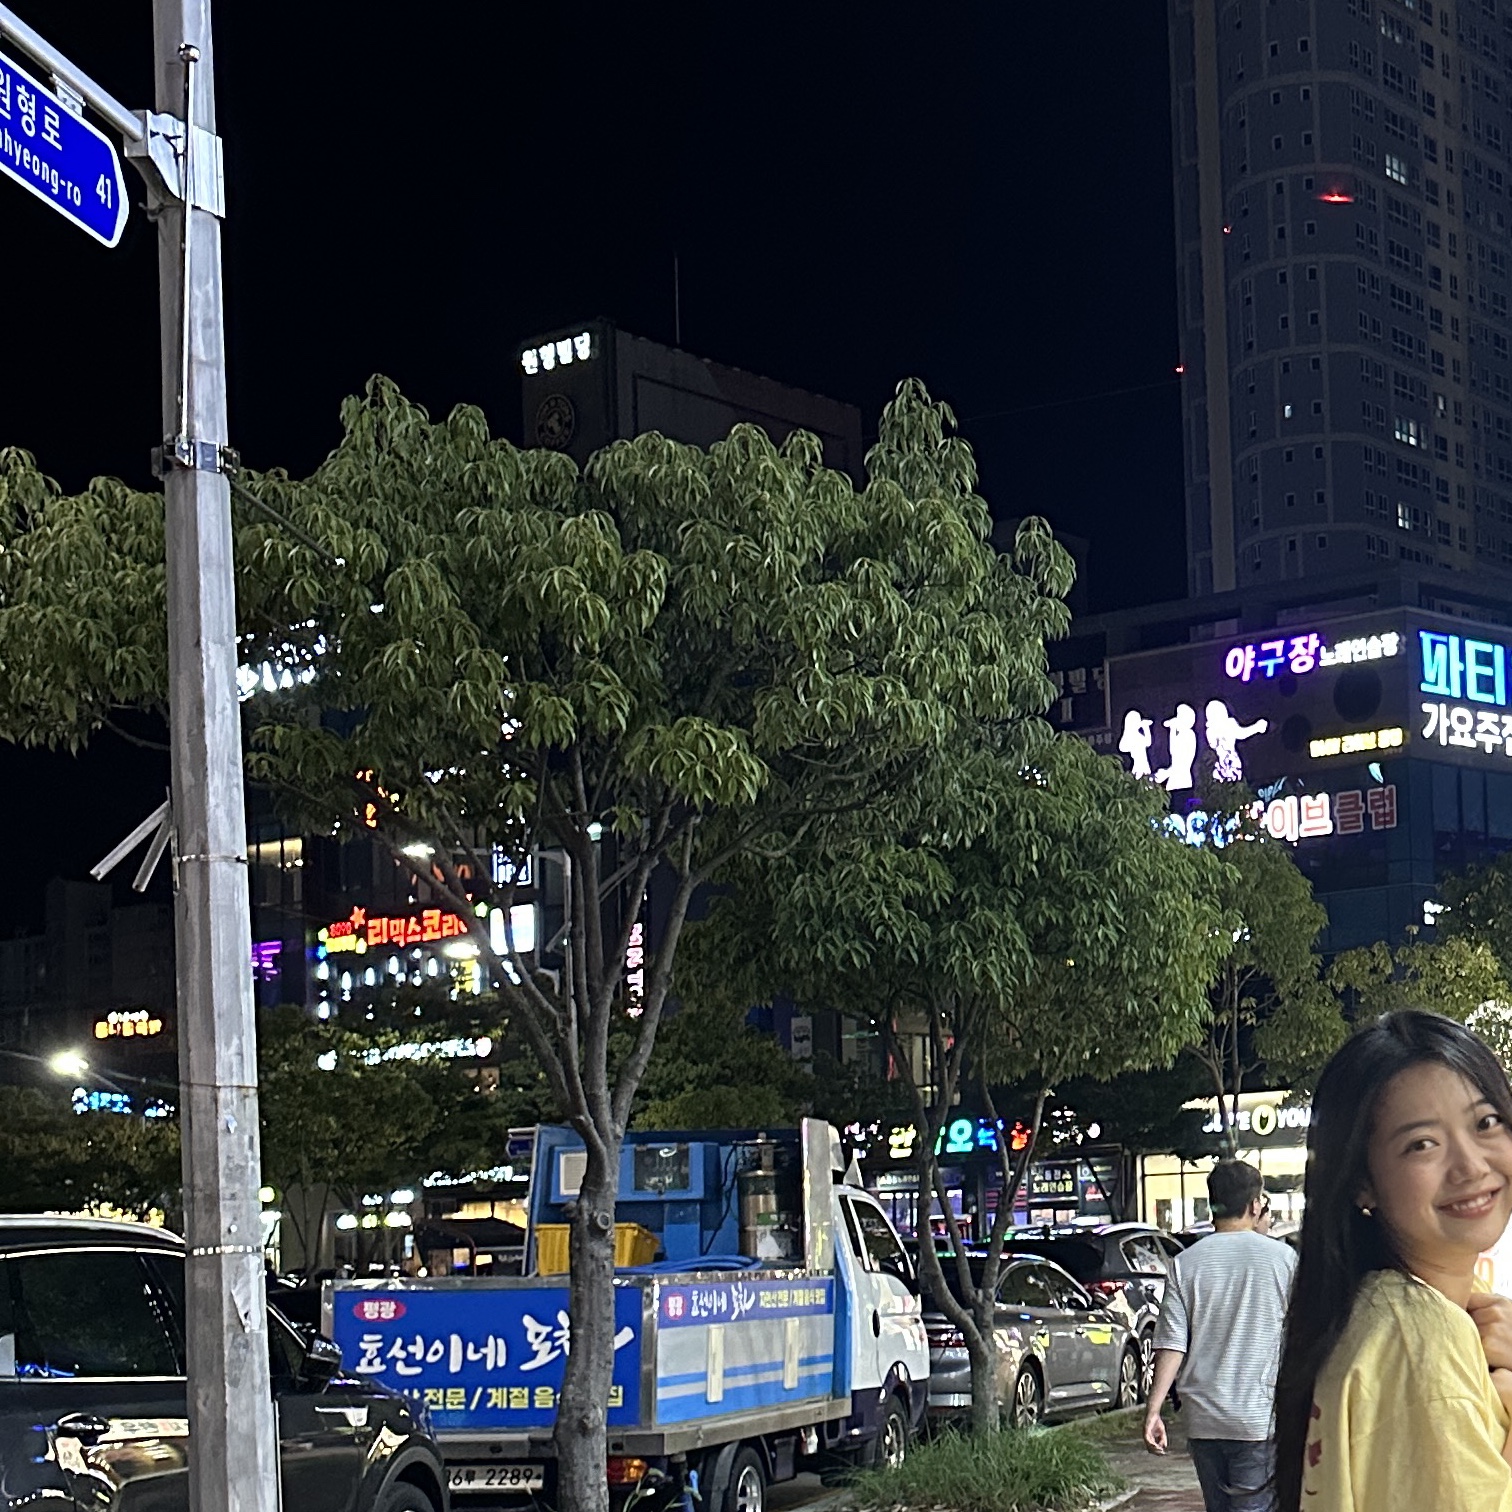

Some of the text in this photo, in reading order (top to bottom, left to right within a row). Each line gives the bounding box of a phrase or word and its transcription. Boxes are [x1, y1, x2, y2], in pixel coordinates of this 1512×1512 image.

[96, 174, 112, 209] 41
[1225, 633, 1320, 682] 야구장
[355, 1333, 507, 1376] 효선이네
[486, 1386, 530, 1410] 계절
[485, 1468, 533, 1486] 2289
